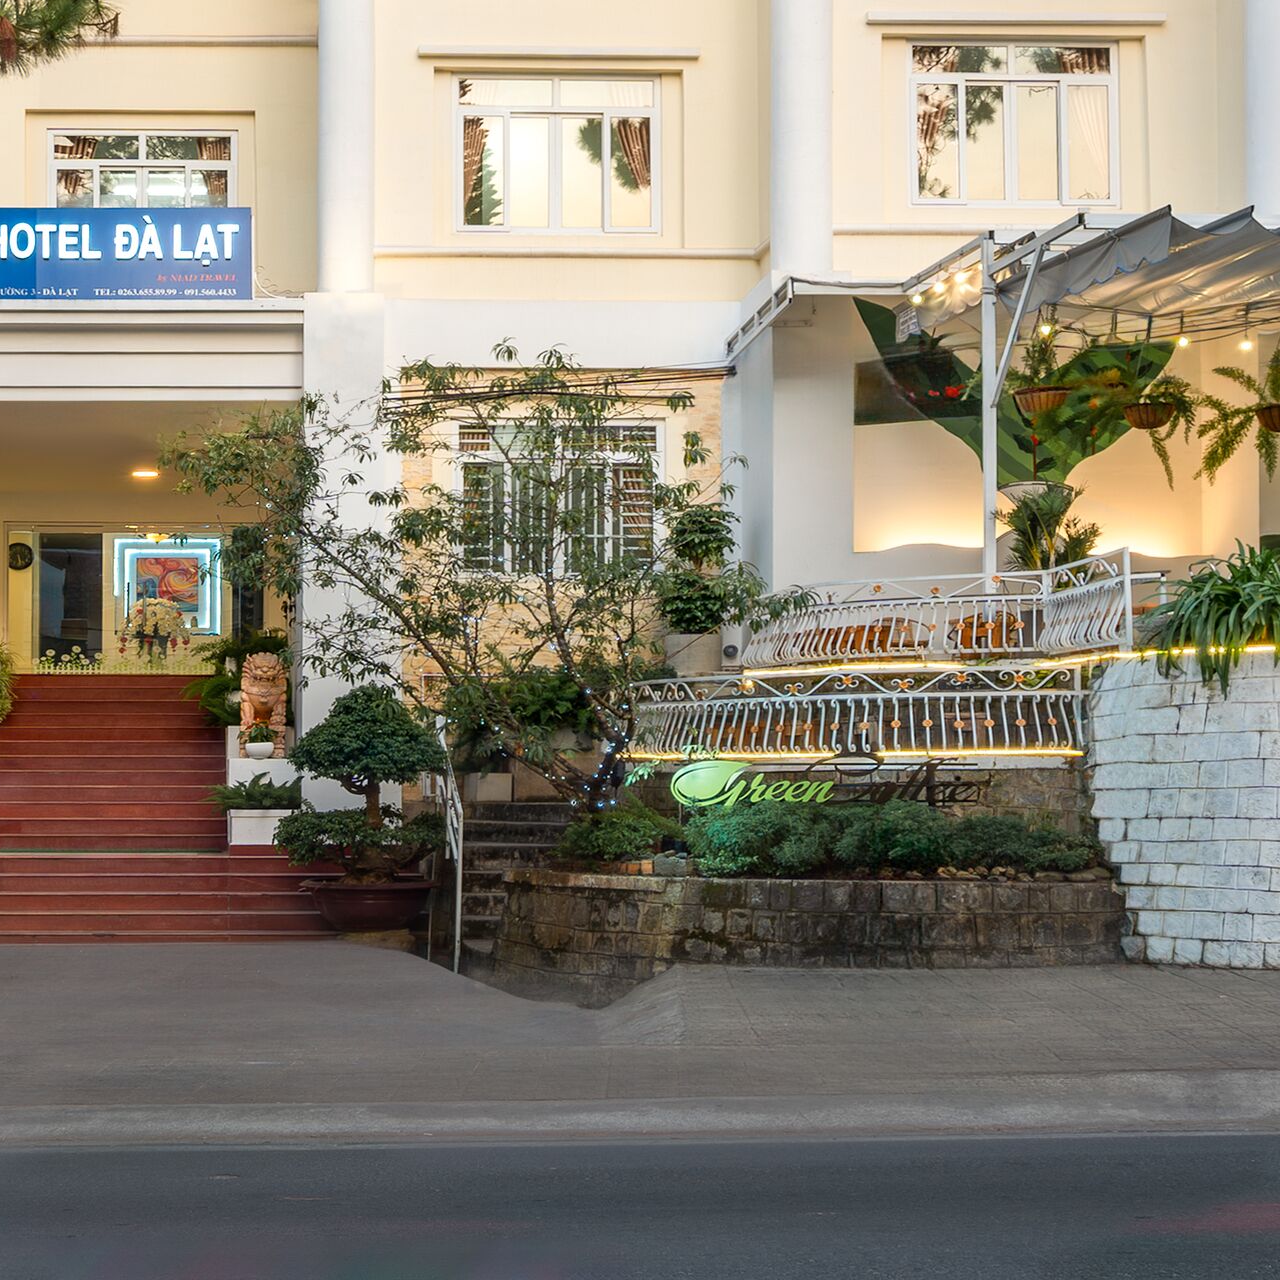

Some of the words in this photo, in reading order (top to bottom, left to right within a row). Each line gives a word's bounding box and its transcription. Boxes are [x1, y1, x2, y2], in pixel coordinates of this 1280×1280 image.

[114, 214, 165, 260] ĐÀ
[172, 223, 240, 266] LẠT
[59, 287, 79, 298] LẠT
[93, 287, 116, 296] TEL:
[117, 287, 177, 297] 0263.655.89.99
[670, 760, 835, 807] Green
